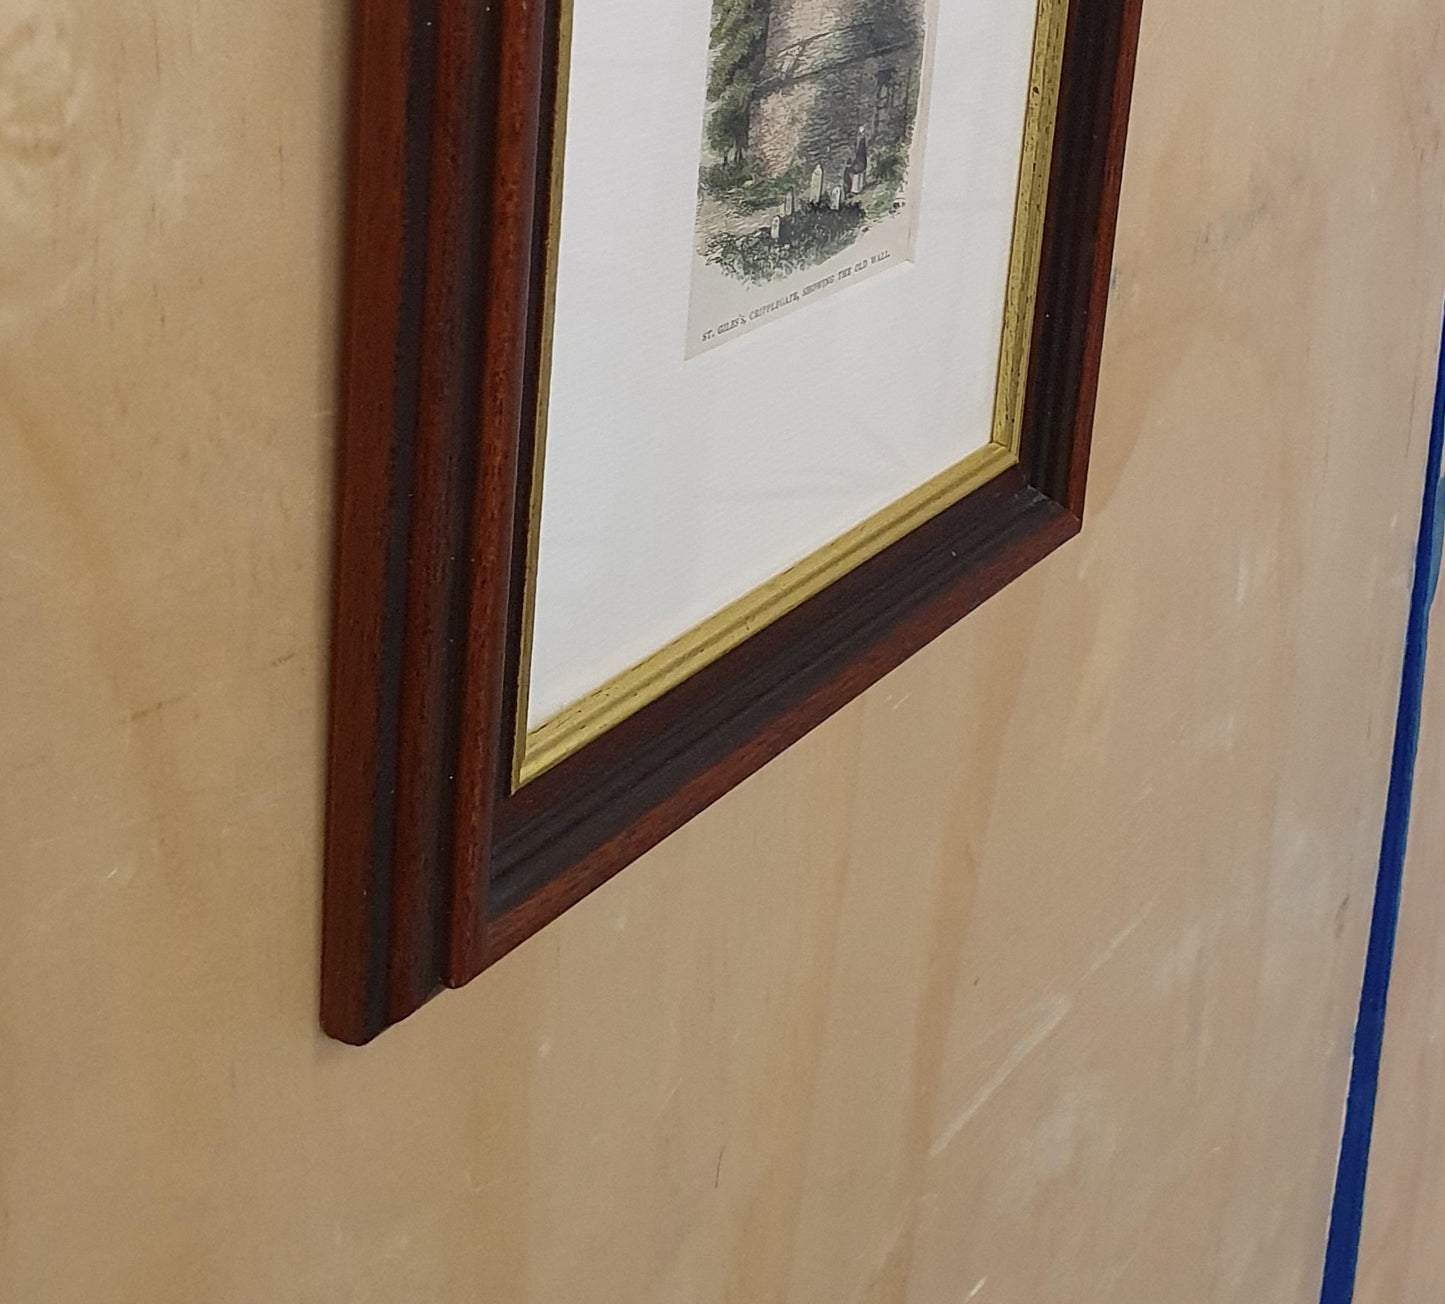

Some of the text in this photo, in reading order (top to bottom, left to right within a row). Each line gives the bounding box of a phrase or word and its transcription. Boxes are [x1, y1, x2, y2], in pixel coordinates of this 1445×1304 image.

[802, 274, 835, 296] SHOWING
[838, 267, 852, 280] THE
[854, 259, 868, 273] OLD
